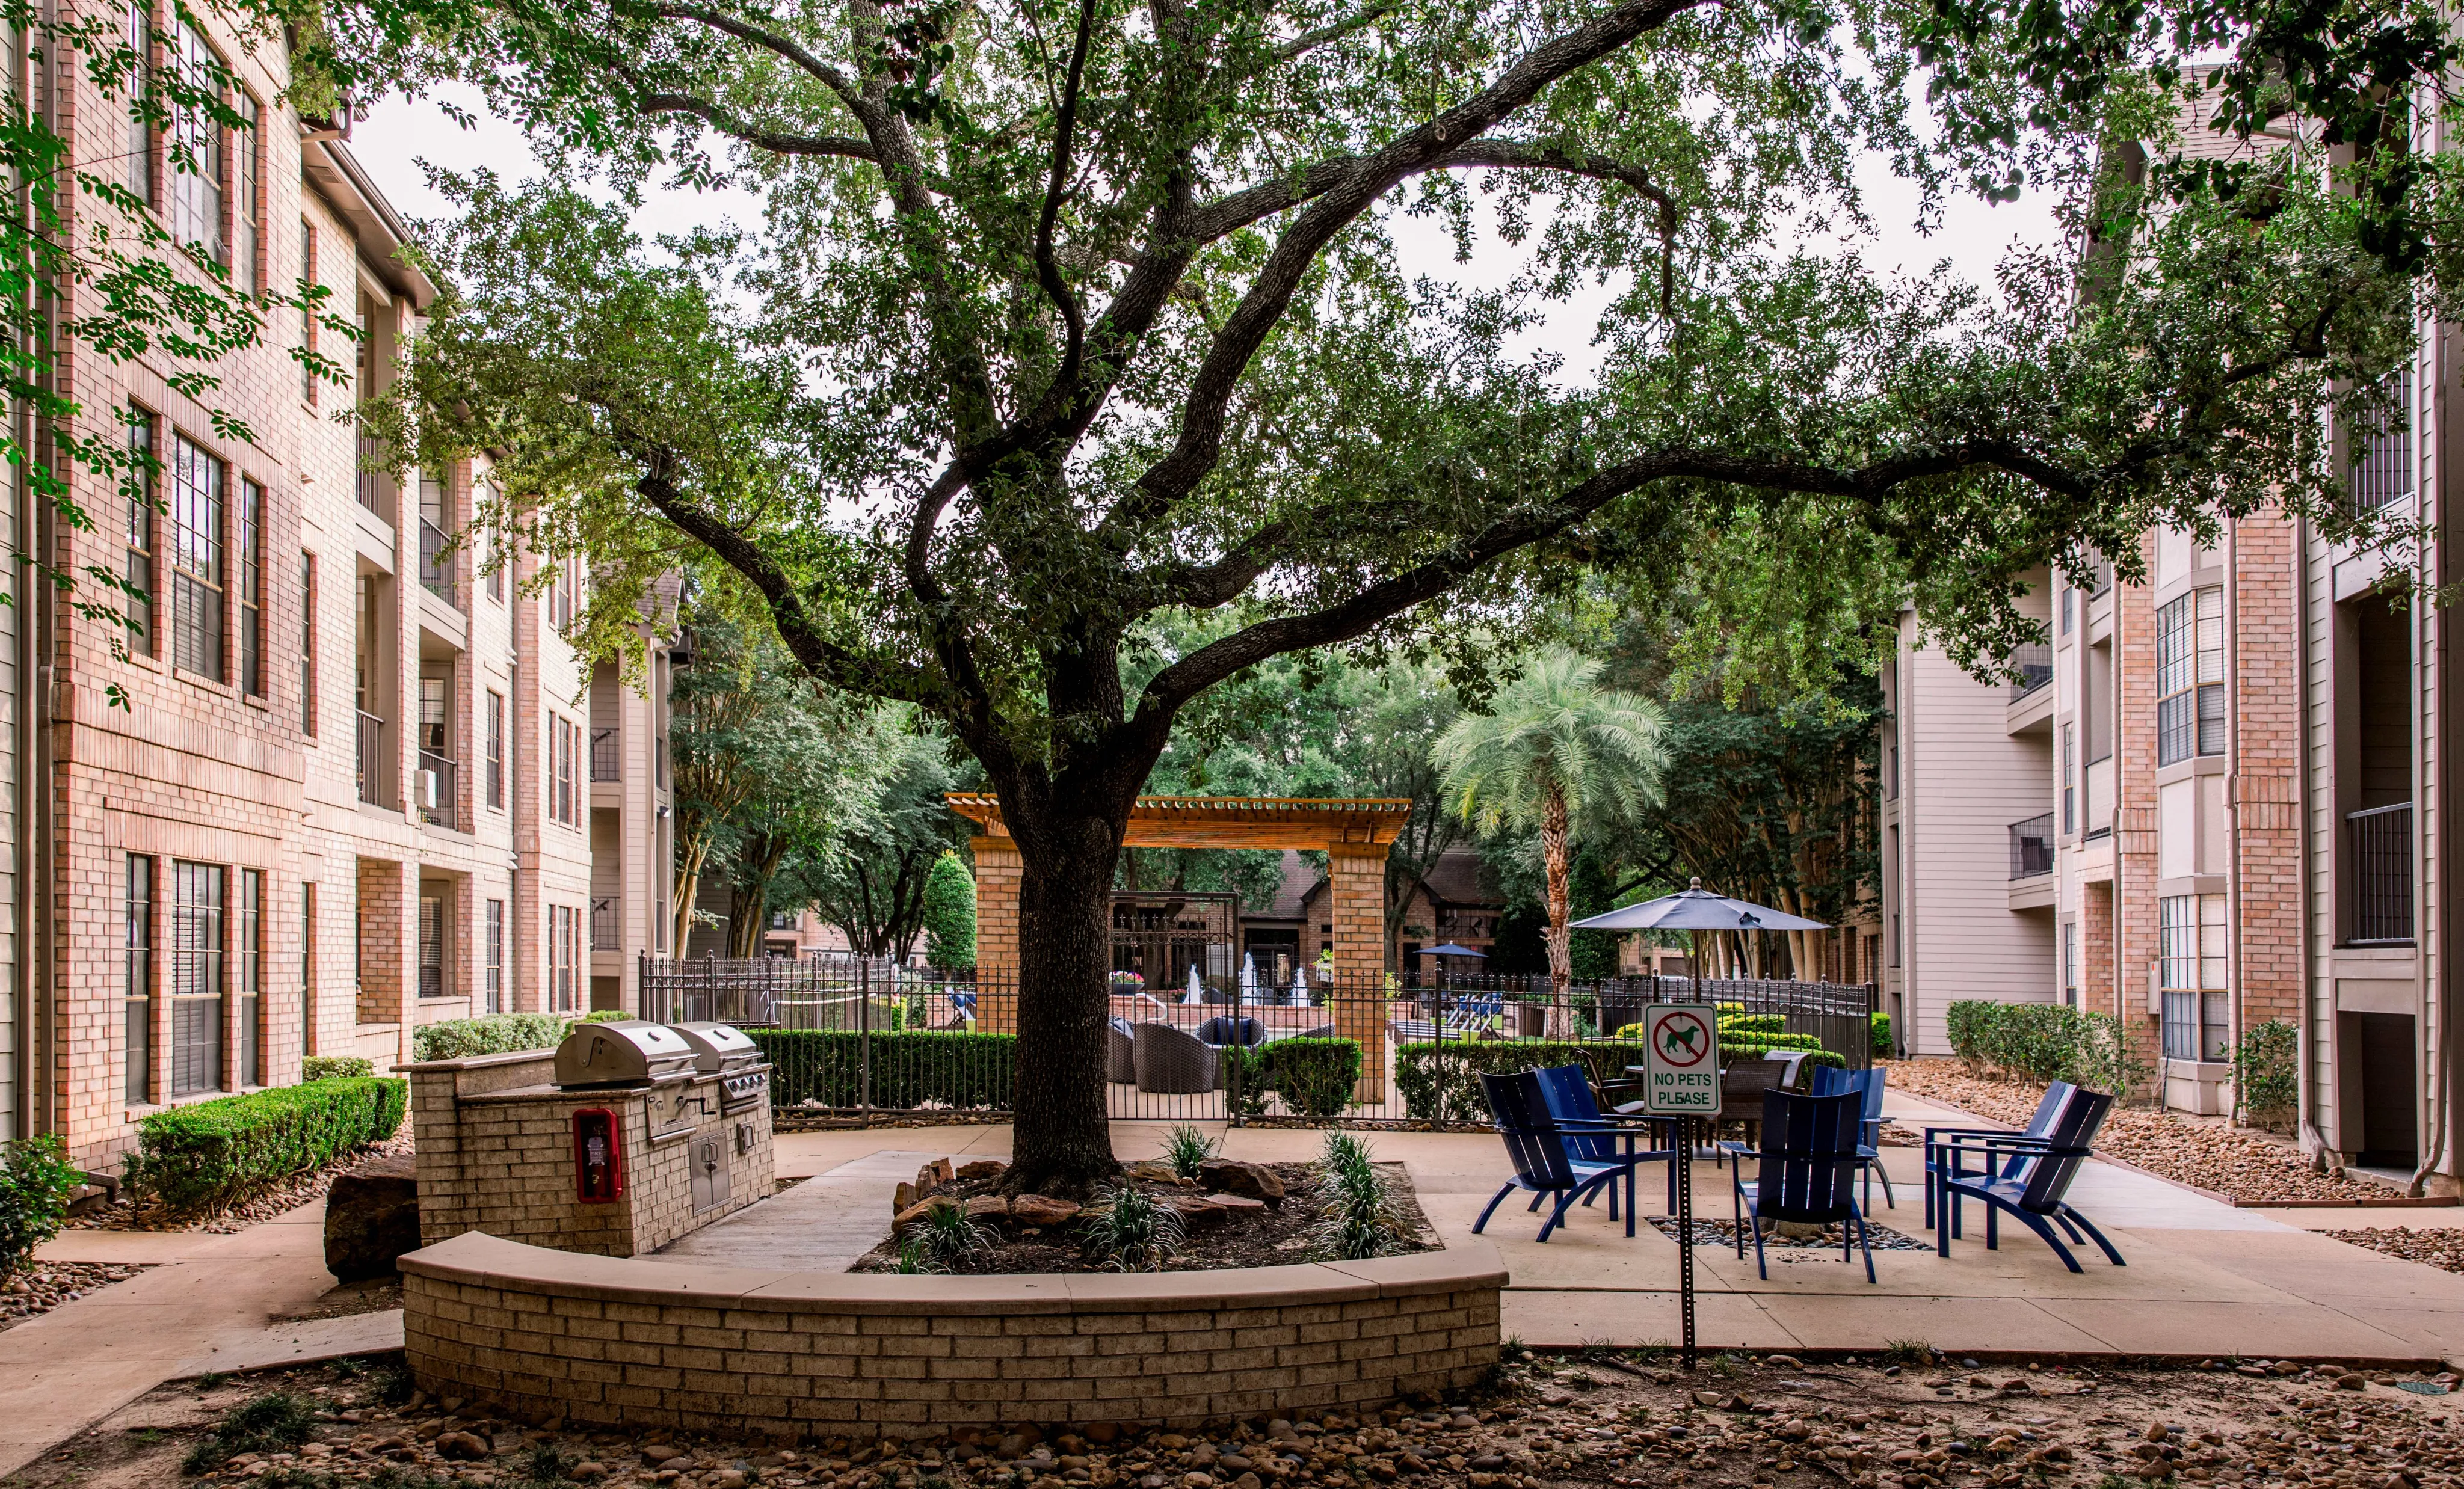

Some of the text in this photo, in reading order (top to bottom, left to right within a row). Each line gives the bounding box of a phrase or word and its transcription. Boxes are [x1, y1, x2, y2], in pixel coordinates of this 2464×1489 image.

[1655, 1073, 1711, 1086] NO PETS
[1659, 1091, 1710, 1105] PLEASE
